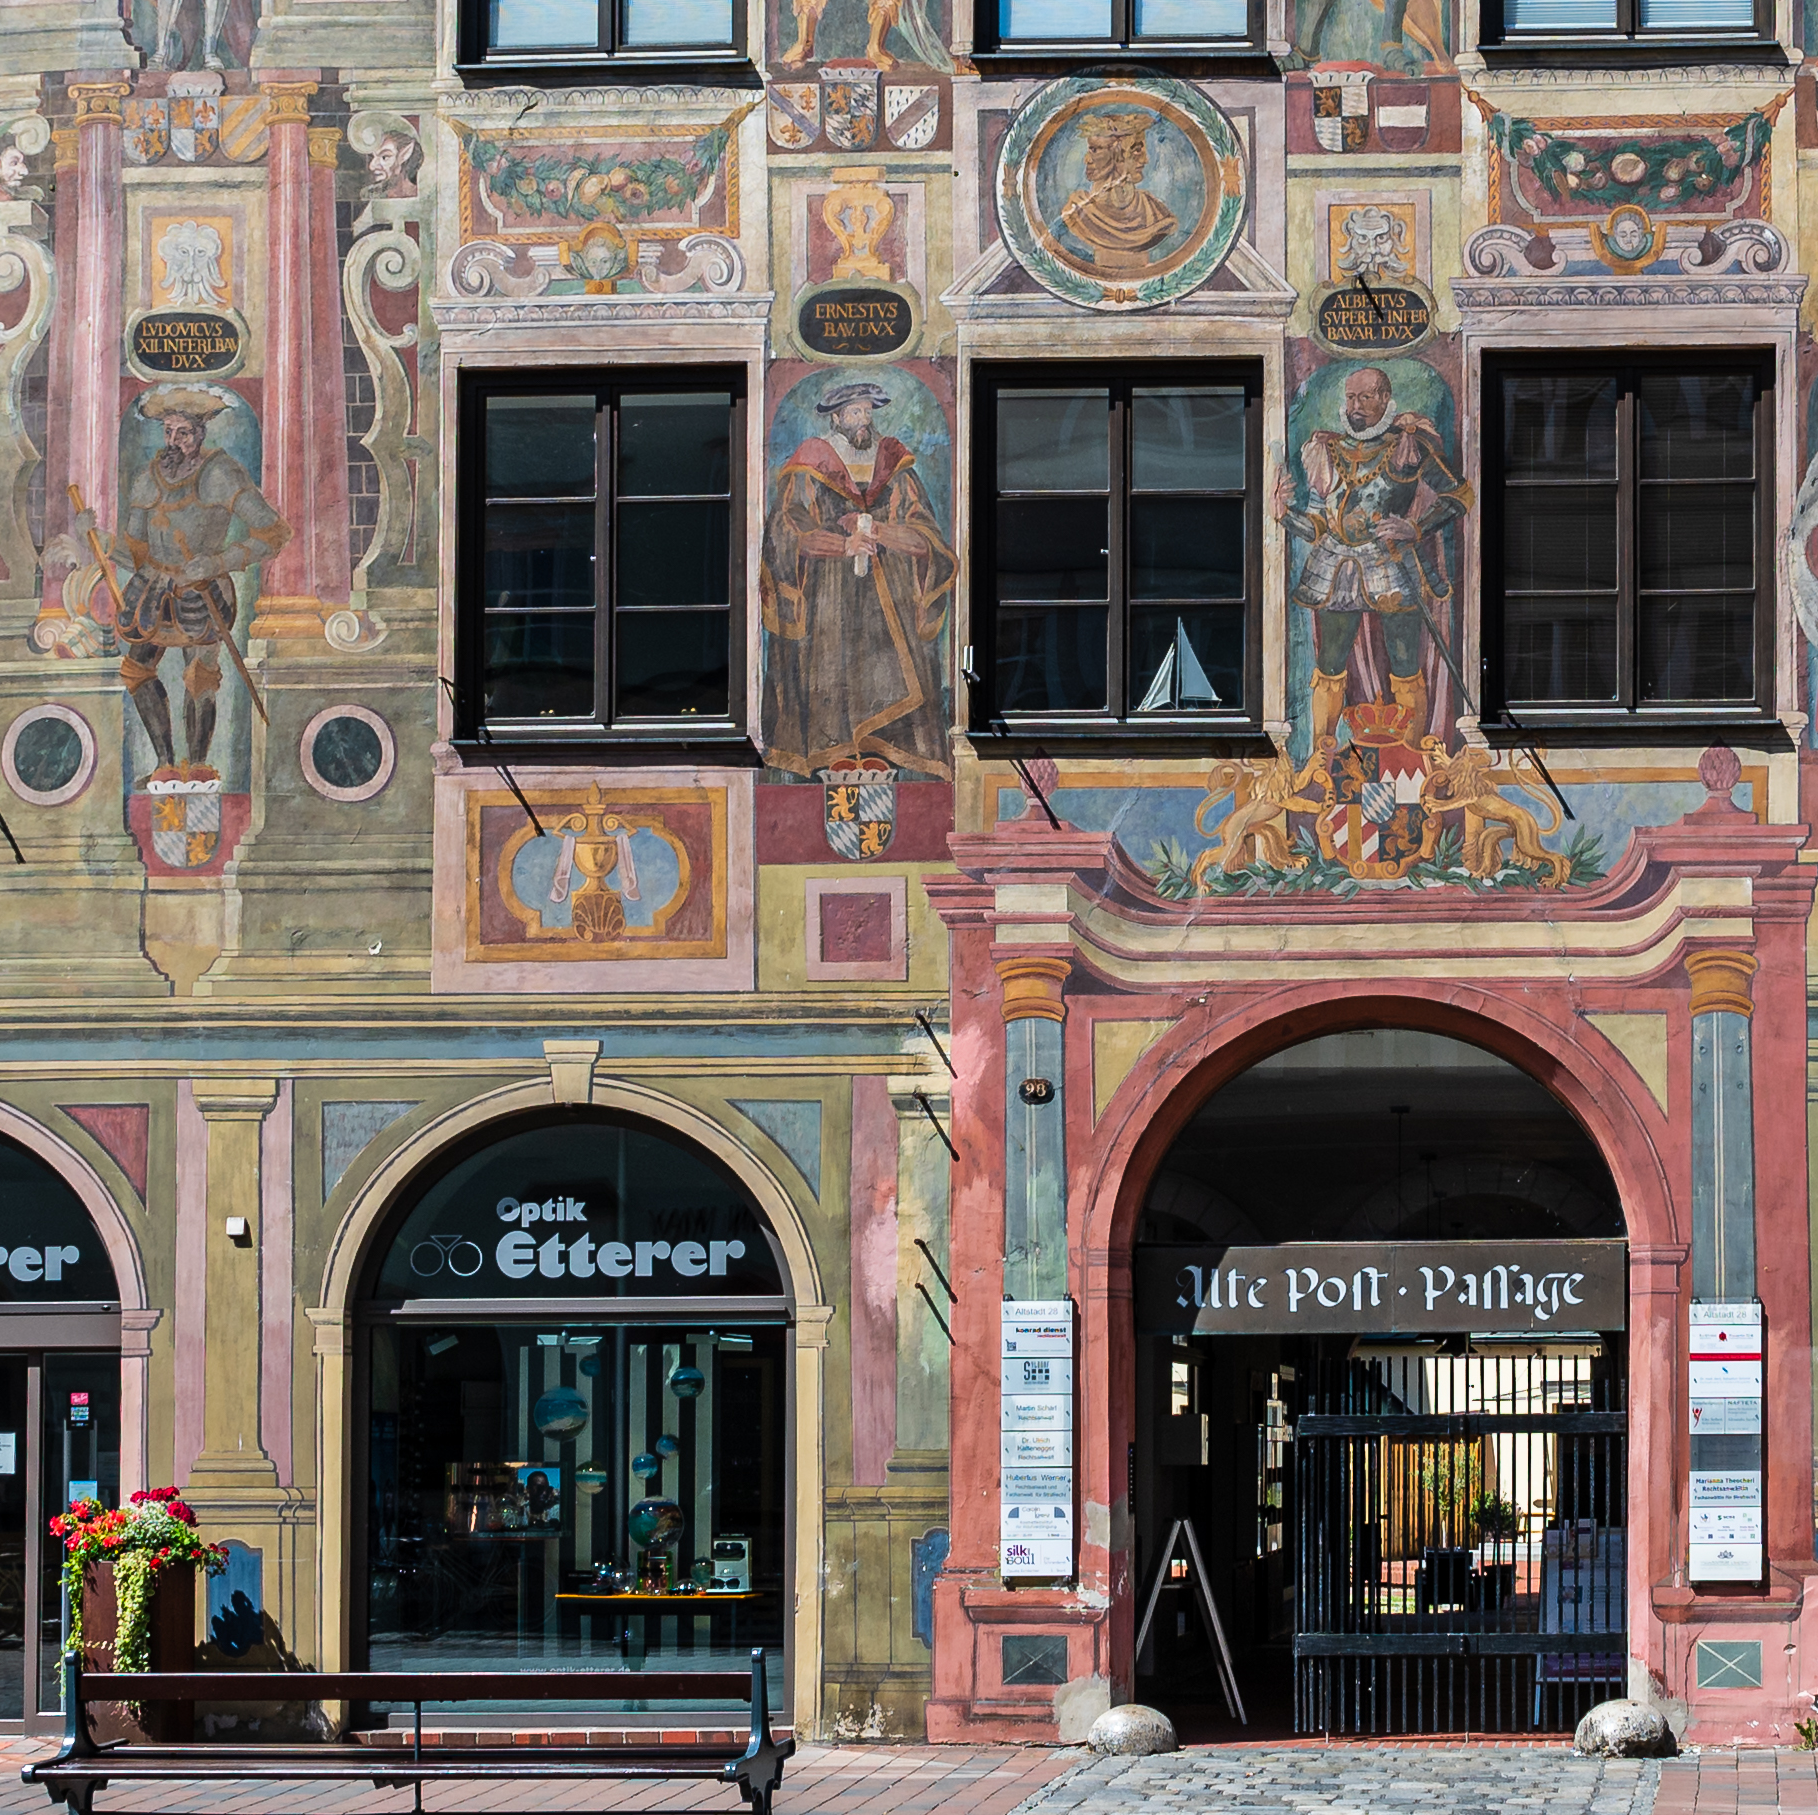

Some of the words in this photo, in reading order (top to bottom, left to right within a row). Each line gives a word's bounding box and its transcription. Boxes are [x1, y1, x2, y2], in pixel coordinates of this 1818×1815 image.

[815, 304, 898, 319] ERNESTVS
[141, 322, 223, 337] LVDOVICVS
[859, 322, 896, 336] DVX
[1381, 326, 1415, 340] DVX
[171, 355, 206, 369] DVX
[1025, 1083, 1047, 1097] 98
[497, 1196, 587, 1227] Optik
[496, 1231, 746, 1278] Etterer
[1176, 1265, 1268, 1309] Alte
[1015, 1307, 1046, 1316] Altstadt
[1047, 1307, 1059, 1316] 28
[1703, 1310, 1734, 1319] Altstadt
[1736, 1310, 1747, 1319] 28
[1015, 1326, 1042, 1334] konrad
[1043, 1326, 1067, 1334] dienst
[1005, 1474, 1038, 1482] Hubertus
[1006, 1544, 1028, 1557] silk
